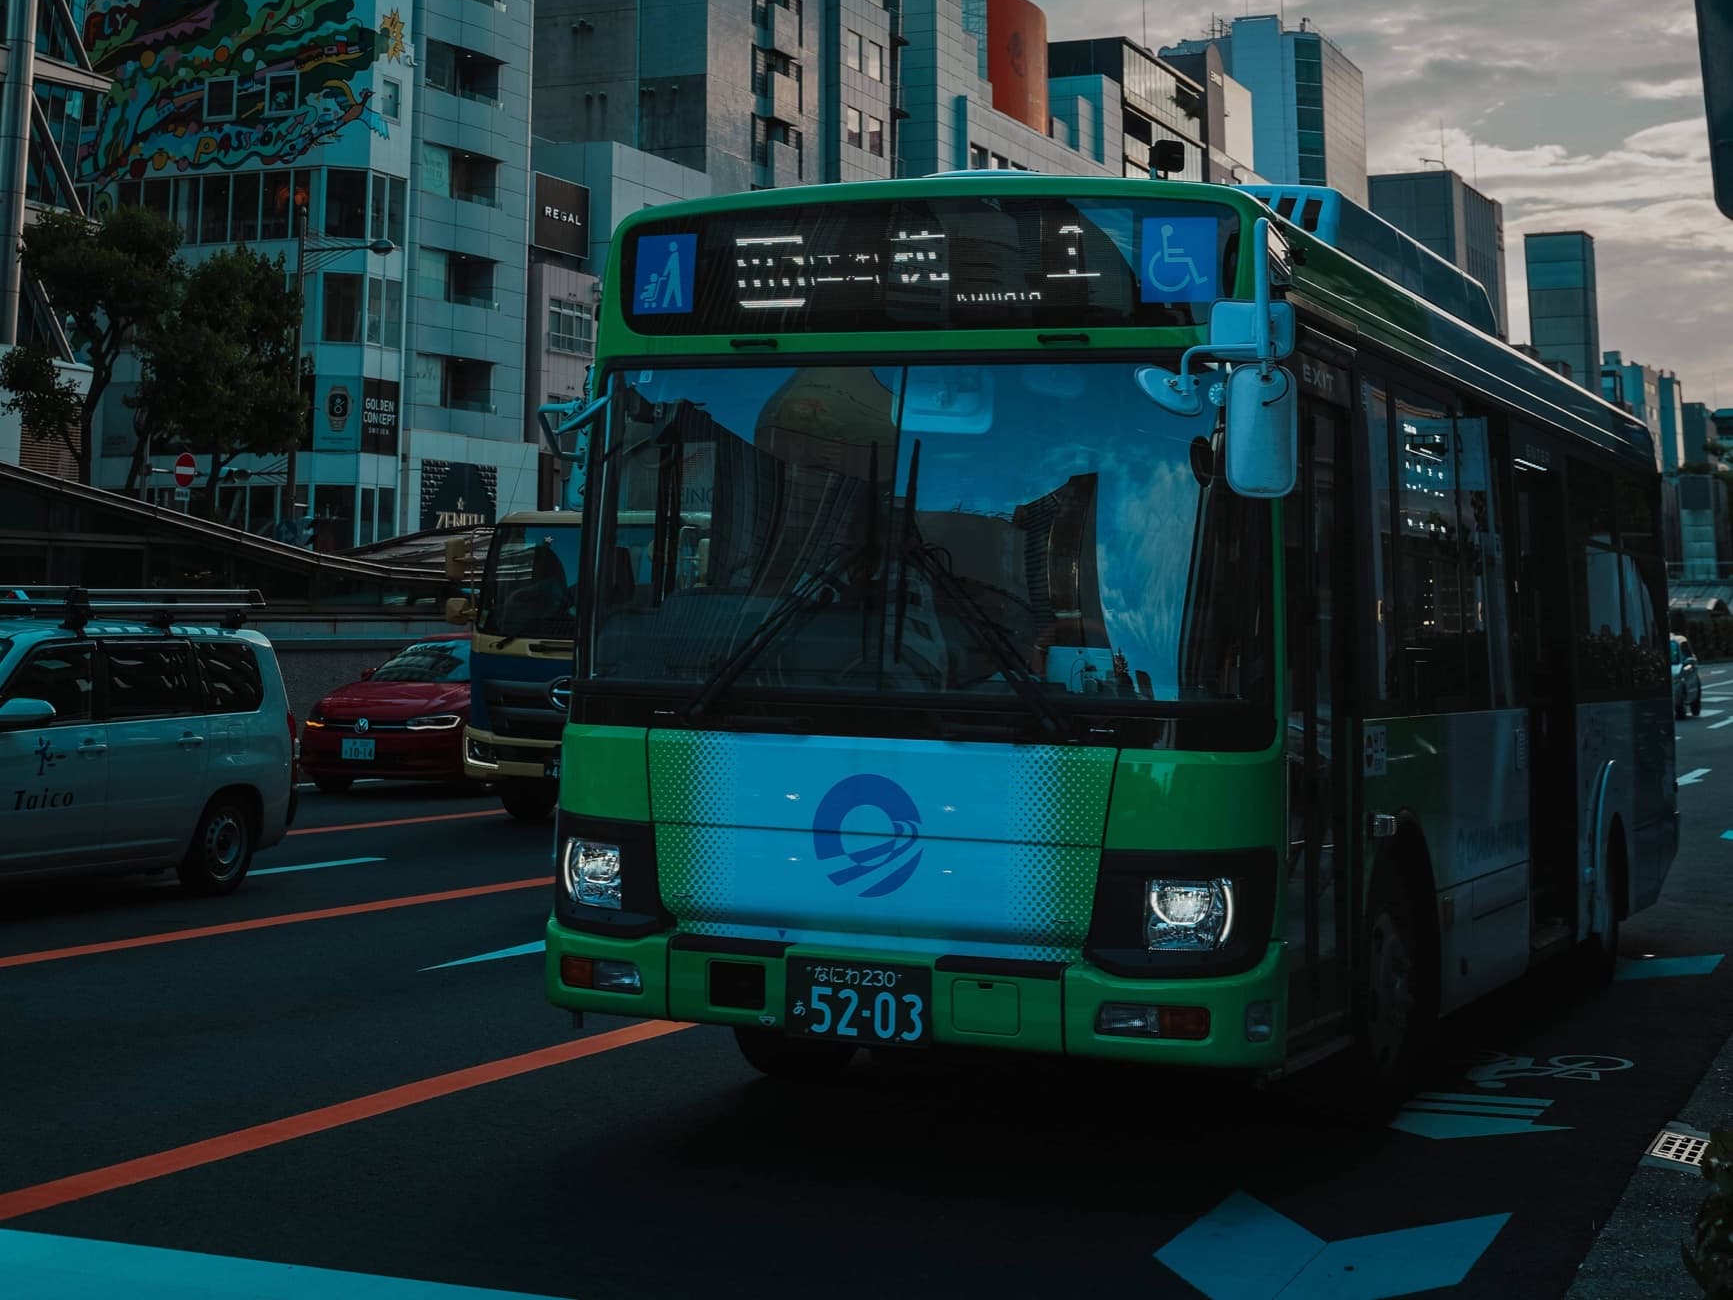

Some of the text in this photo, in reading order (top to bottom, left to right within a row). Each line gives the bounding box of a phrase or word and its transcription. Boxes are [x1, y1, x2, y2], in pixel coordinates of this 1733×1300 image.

[544, 205, 583, 227] REGAL
[1302, 363, 1335, 393] EXIT
[365, 397, 395, 412] GOLDEN
[363, 411, 397, 426] CONCEPT
[14, 787, 74, 811] Taico
[793, 986, 924, 1042] あ 52-03
